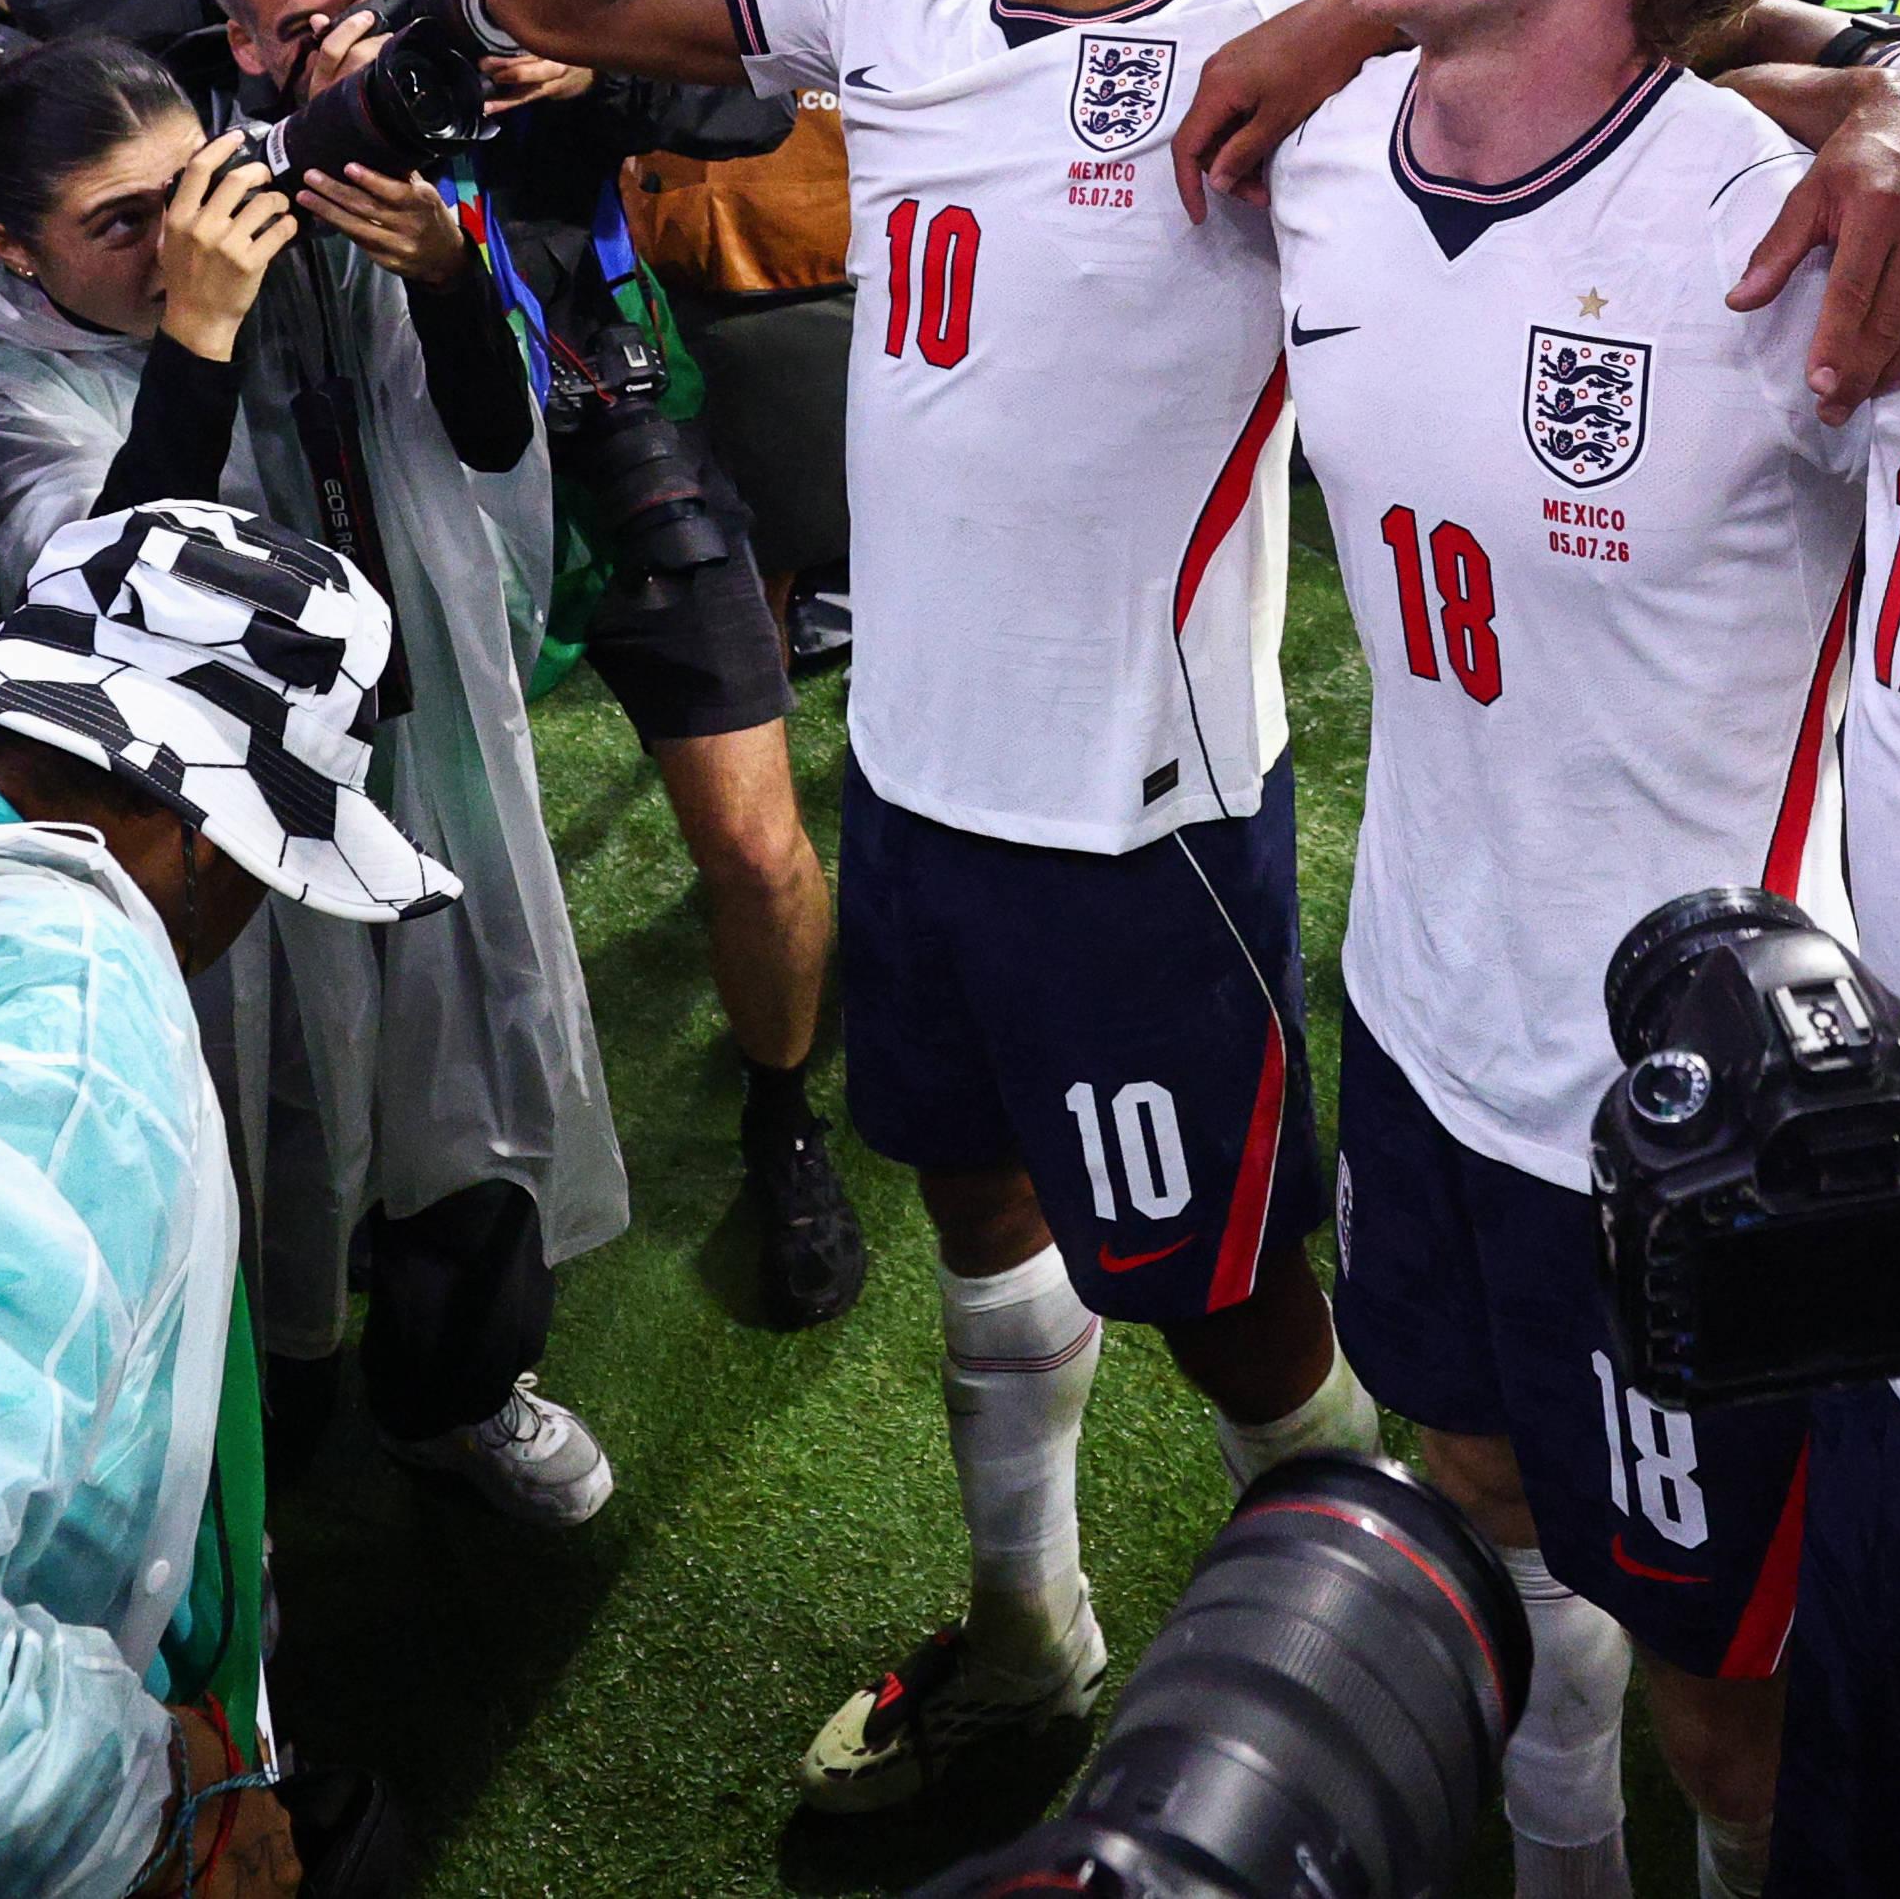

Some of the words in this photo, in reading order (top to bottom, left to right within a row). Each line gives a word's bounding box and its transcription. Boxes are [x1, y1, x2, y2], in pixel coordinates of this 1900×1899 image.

[1068, 161, 1135, 183] MEXICO
[1068, 186, 1134, 209] 05.07.26
[885, 198, 982, 370] 10
[324, 479, 350, 528] EOS
[1543, 498, 1625, 531] MEXICO
[1548, 531, 1631, 563] 05.07.26
[1381, 503, 1503, 707] 18
[1064, 1080, 1193, 1223] 10
[1588, 1347, 1709, 1550] 18
